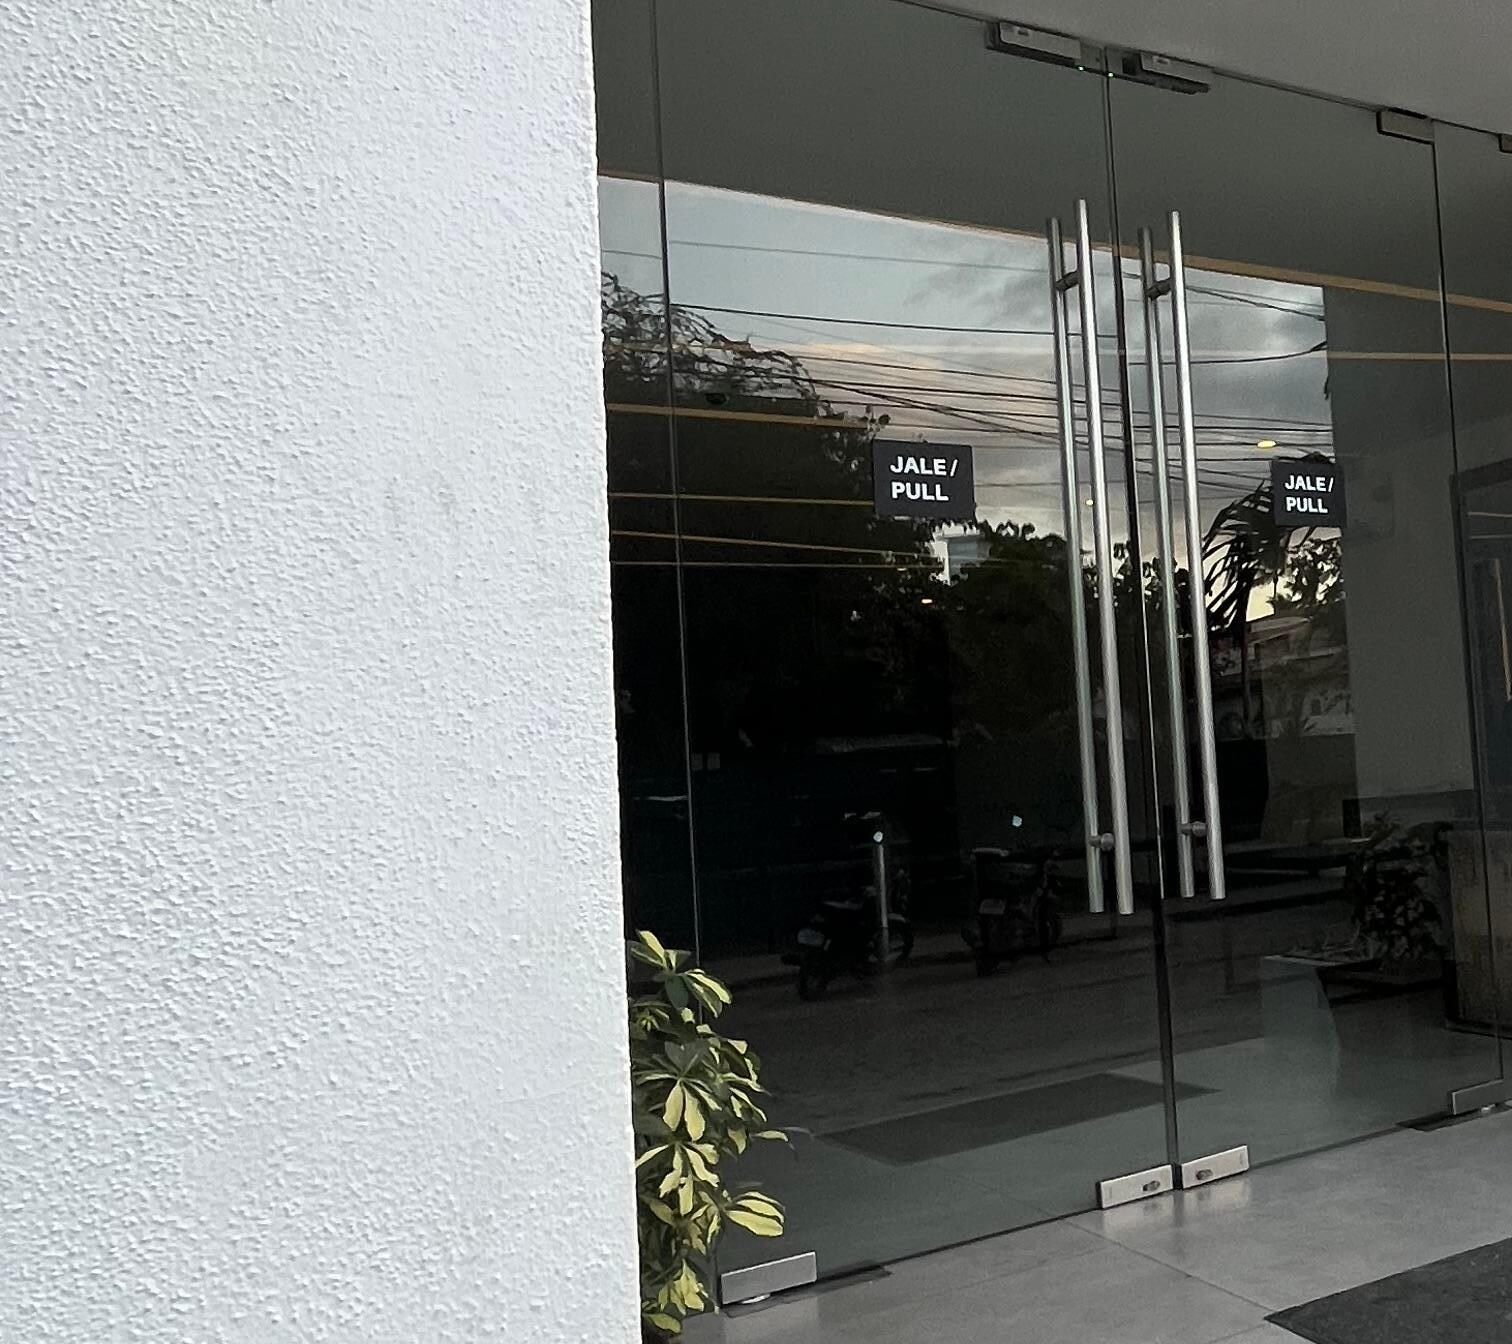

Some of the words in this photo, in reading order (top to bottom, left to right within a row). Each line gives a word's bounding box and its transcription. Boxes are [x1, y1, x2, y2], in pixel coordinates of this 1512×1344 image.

[889, 456, 959, 477] JALE/
[891, 481, 949, 501] PULL
[1284, 474, 1334, 492] JALE/
[1285, 496, 1329, 514] PULL
